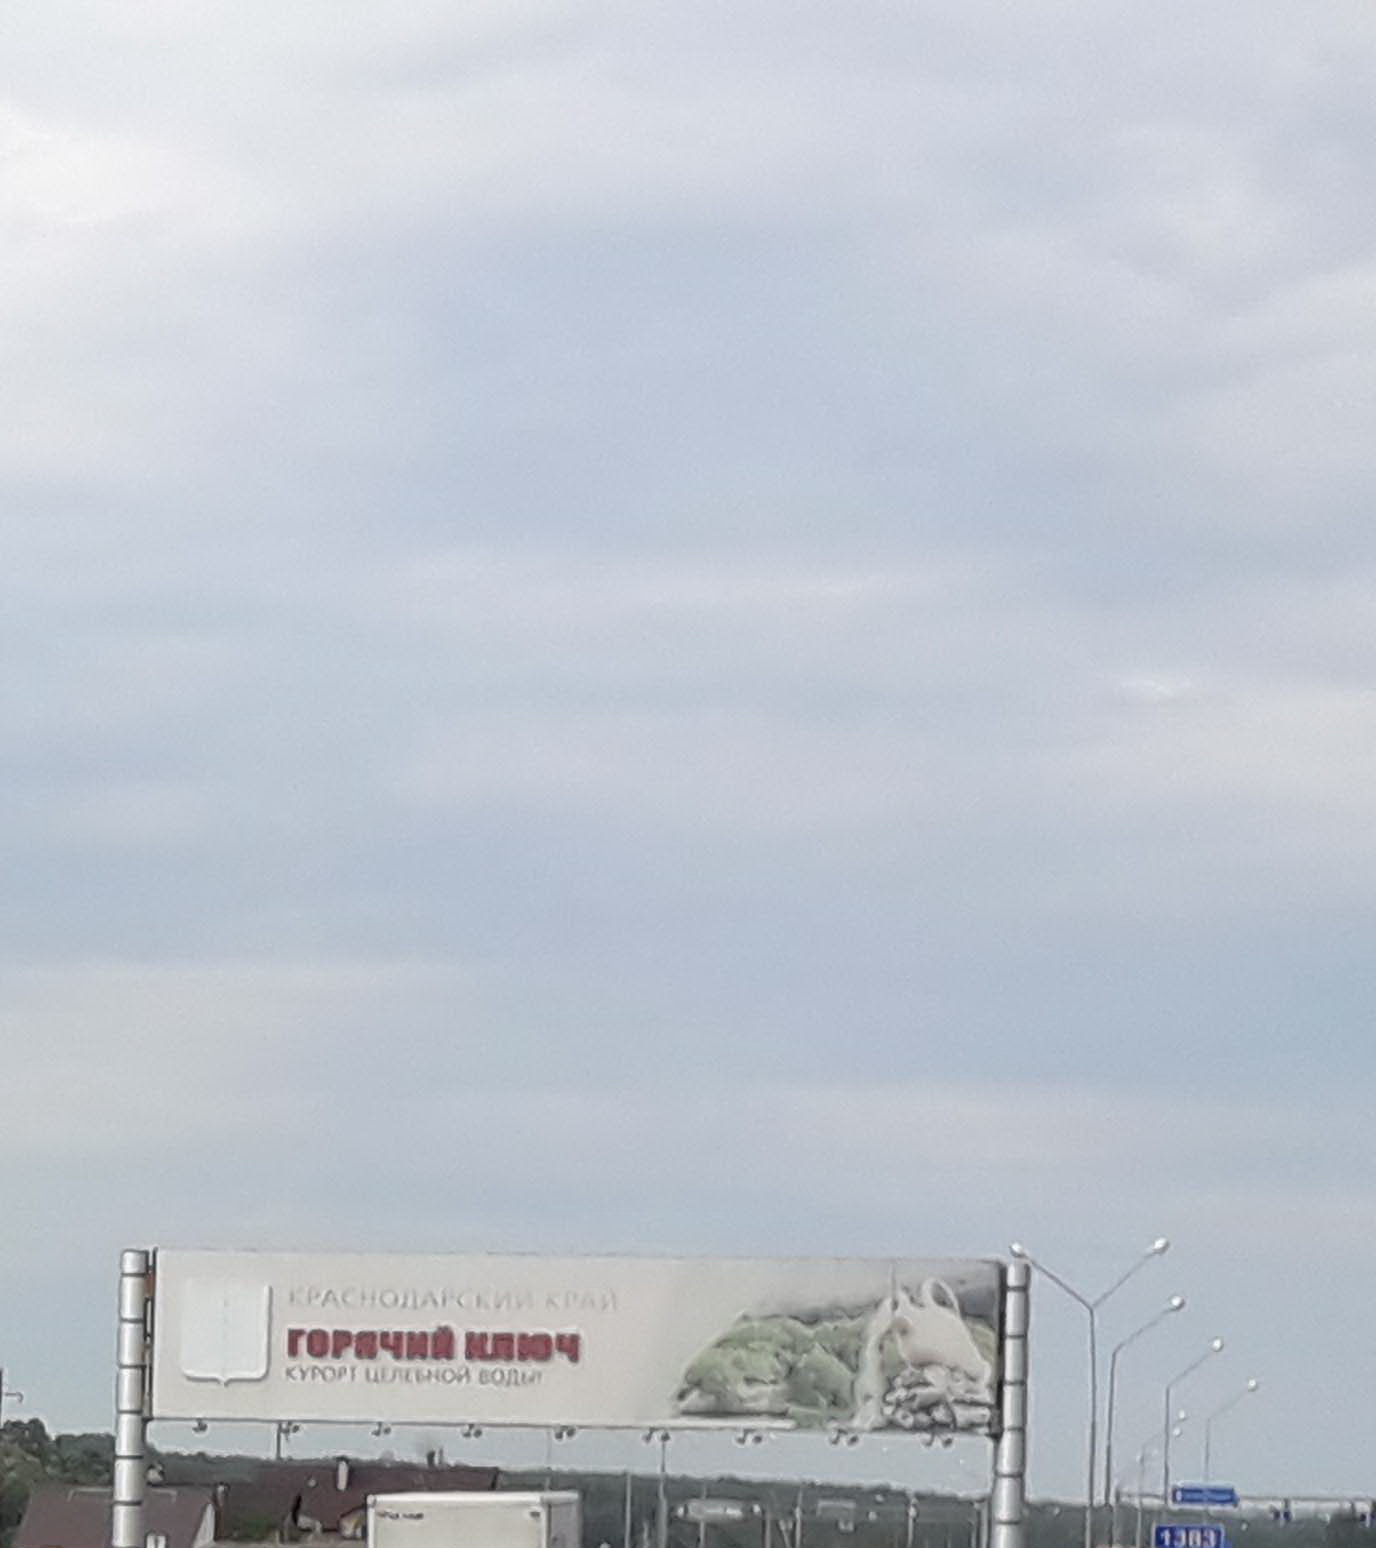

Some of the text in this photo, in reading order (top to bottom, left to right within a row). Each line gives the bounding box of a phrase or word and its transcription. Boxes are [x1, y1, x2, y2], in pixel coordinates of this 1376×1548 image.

[289, 1287, 619, 1312] КРАСНОДАРСКИЙ КРАЙ
[286, 1326, 581, 1364] ГОРЯЧИЙ КЛЮЧ
[285, 1366, 357, 1382] КУРОРТ
